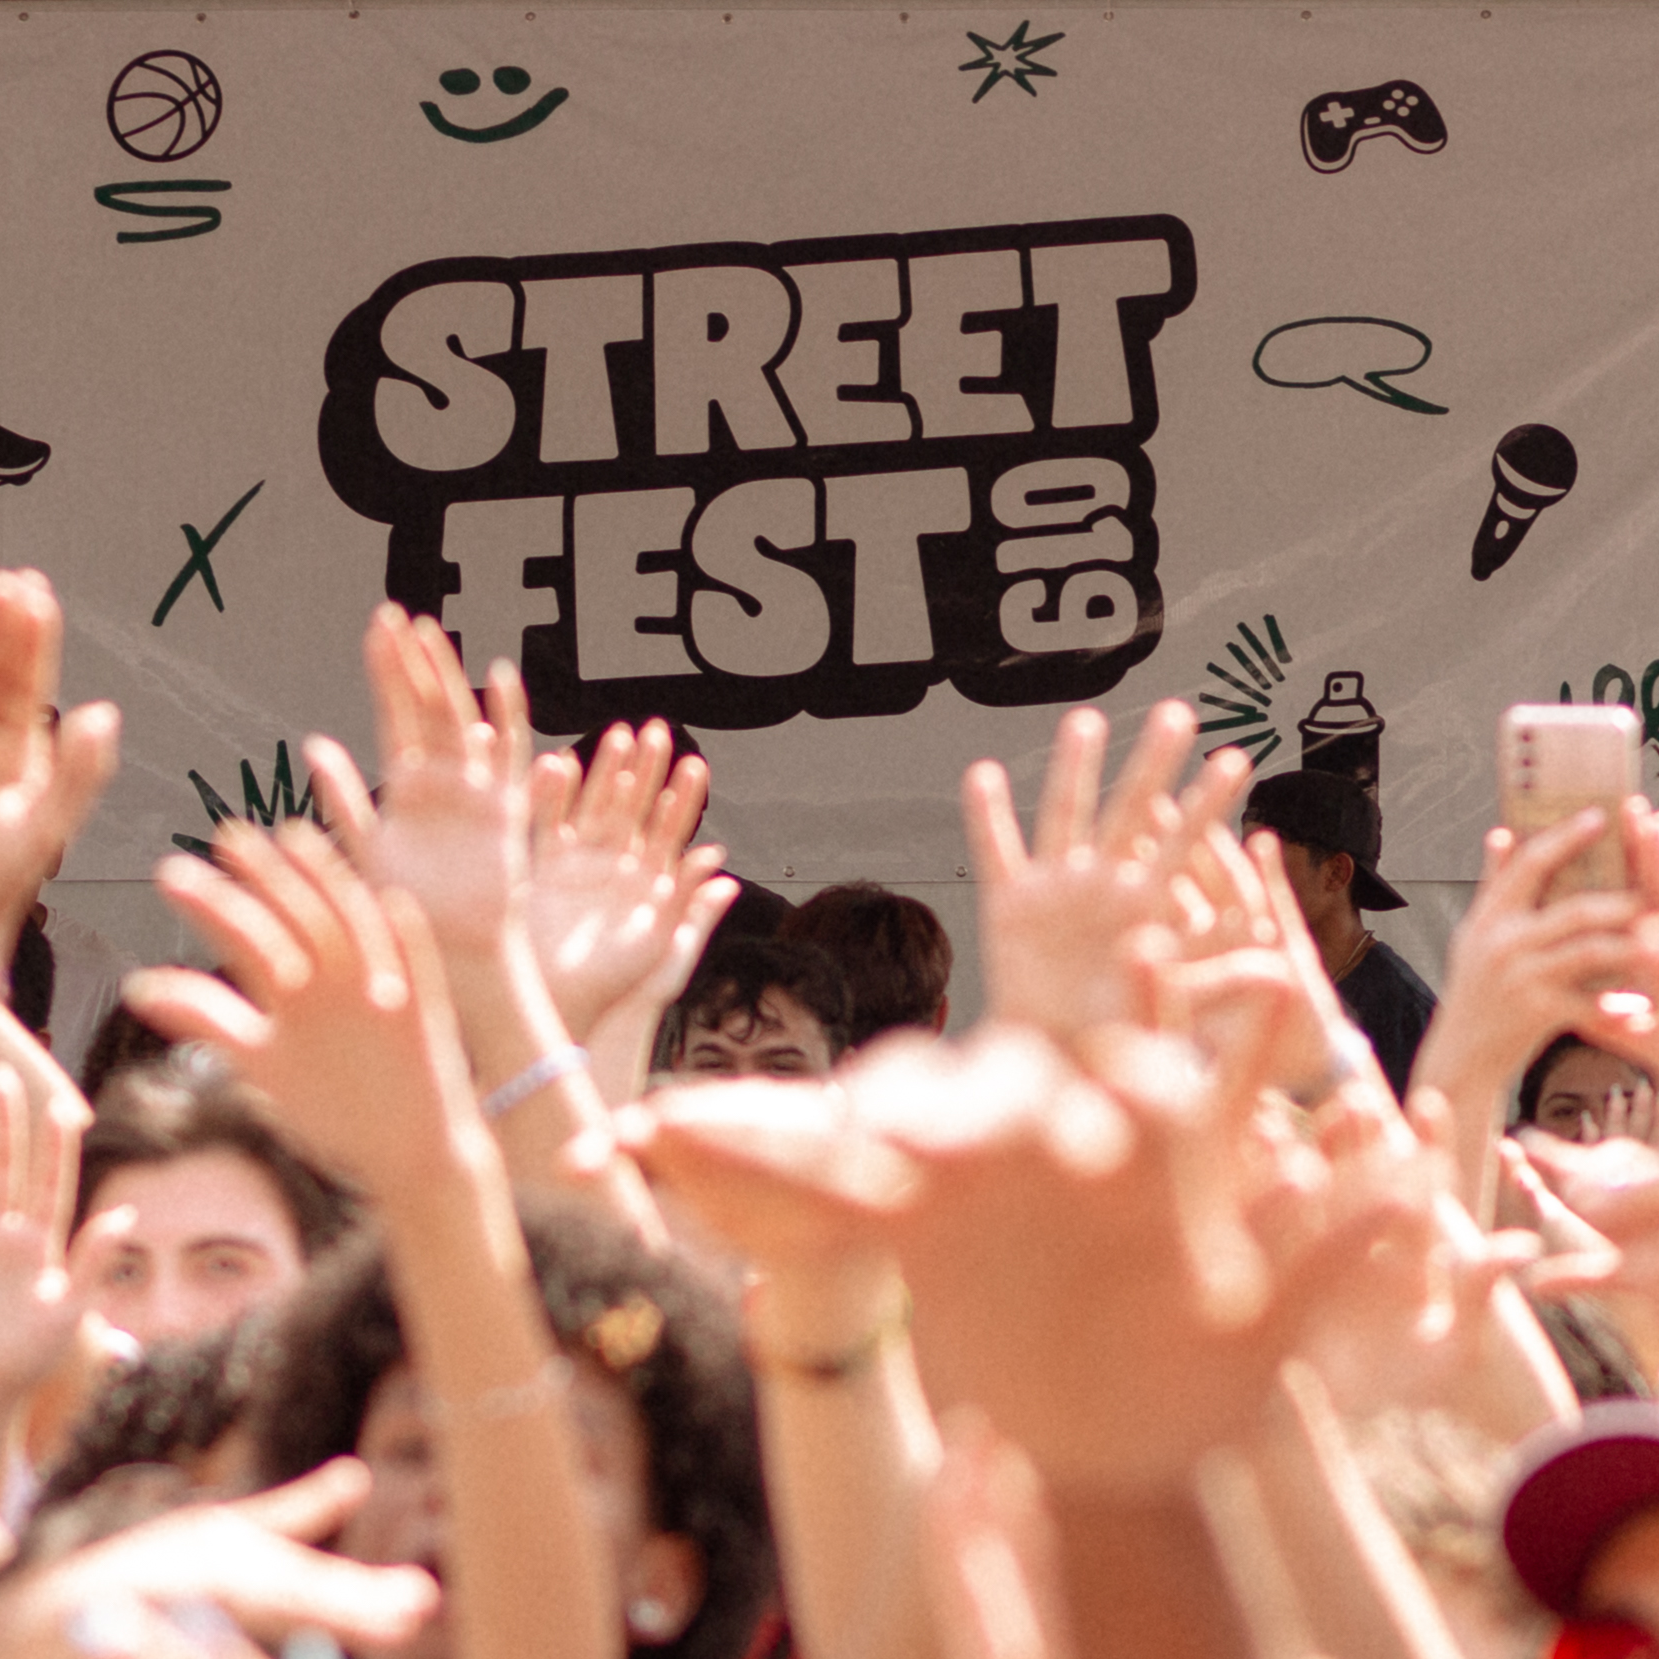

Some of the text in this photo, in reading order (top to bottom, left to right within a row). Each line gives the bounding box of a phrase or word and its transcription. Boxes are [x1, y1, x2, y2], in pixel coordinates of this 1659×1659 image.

[373, 238, 1173, 472] STREET
[441, 466, 972, 690] FEST
[989, 456, 1140, 654] 019
